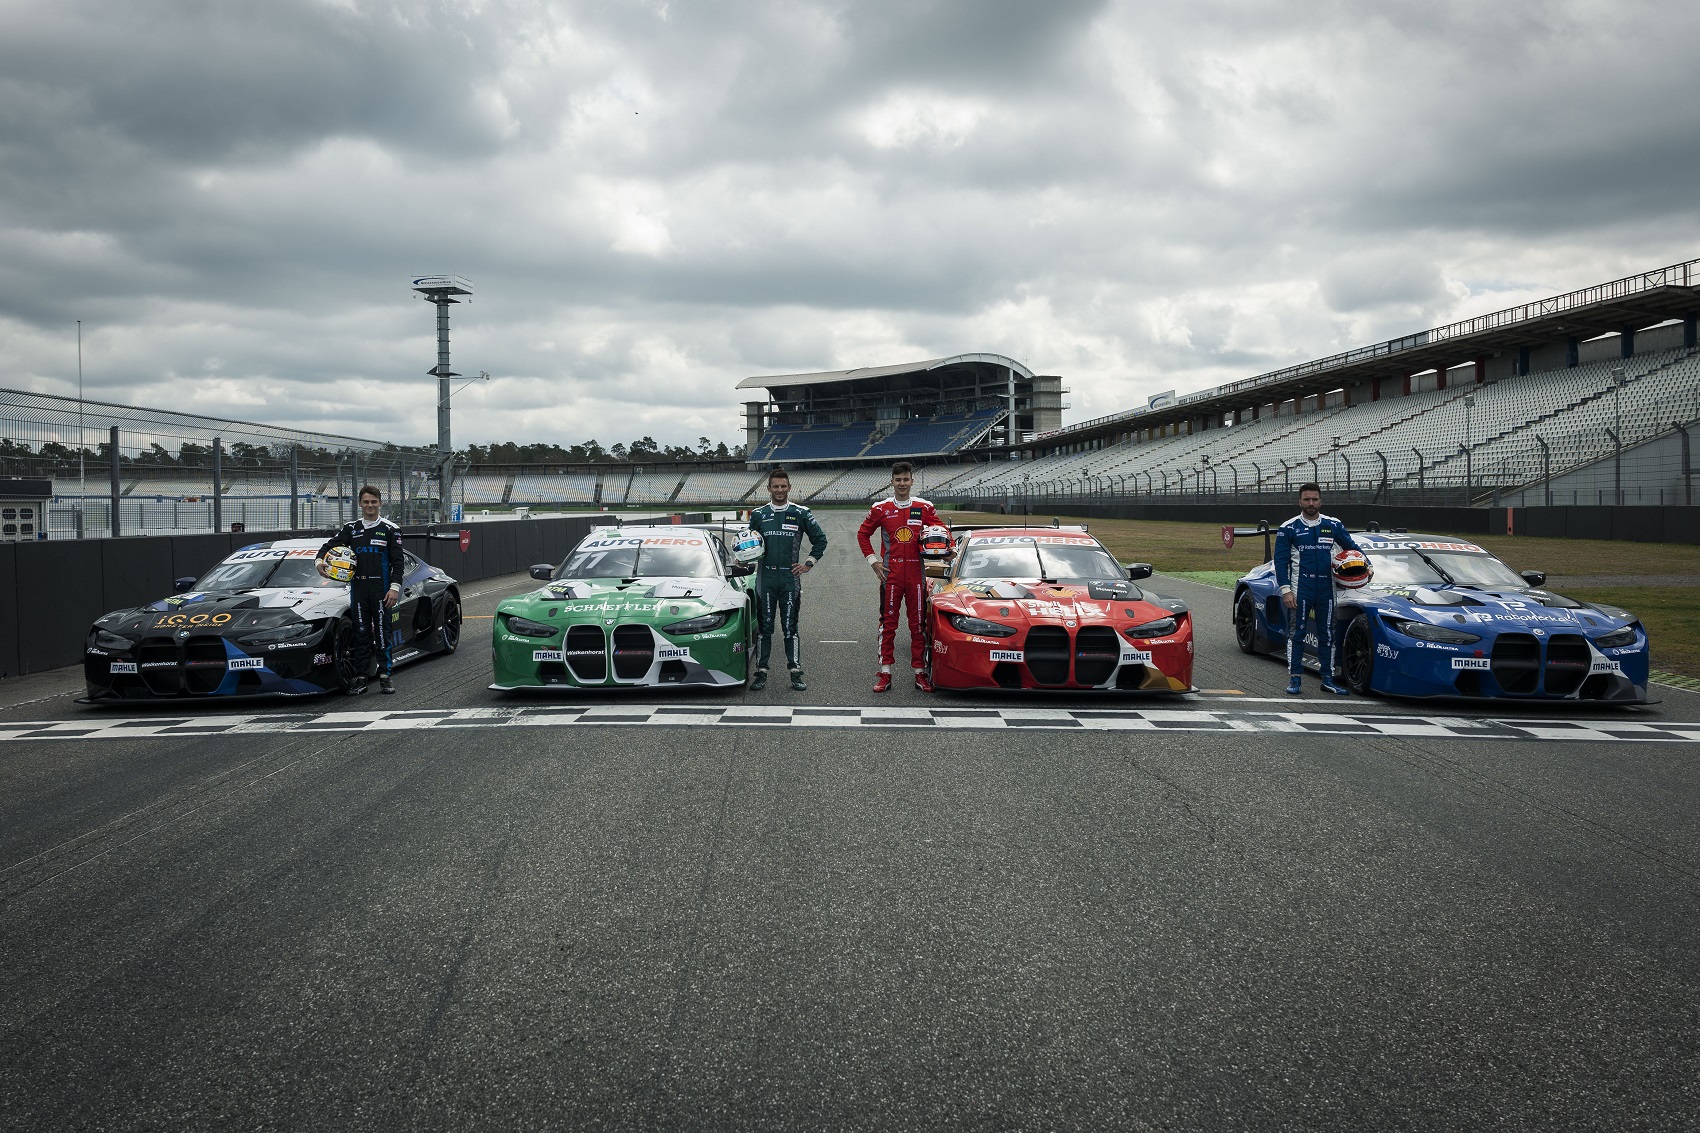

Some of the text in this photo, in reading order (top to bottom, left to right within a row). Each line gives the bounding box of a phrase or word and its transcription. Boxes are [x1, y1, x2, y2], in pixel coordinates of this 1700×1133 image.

[584, 538, 704, 548] AUTOHERO
[974, 537, 1095, 545] AUTOHERO
[1360, 542, 1481, 552] AUTOHERO
[231, 550, 319, 561] AUTOHE
[564, 603, 661, 613] SCHAEFFLER
[534, 652, 562, 660] MAHLE
[658, 648, 688, 658] MAHLE
[992, 651, 1022, 660] MAHLE
[1122, 652, 1150, 661] MAHLE
[111, 664, 136, 672] MAHLE
[231, 659, 262, 668] MAHLE
[1454, 659, 1488, 668] MAHLE
[1592, 662, 1619, 671] MAHLE
